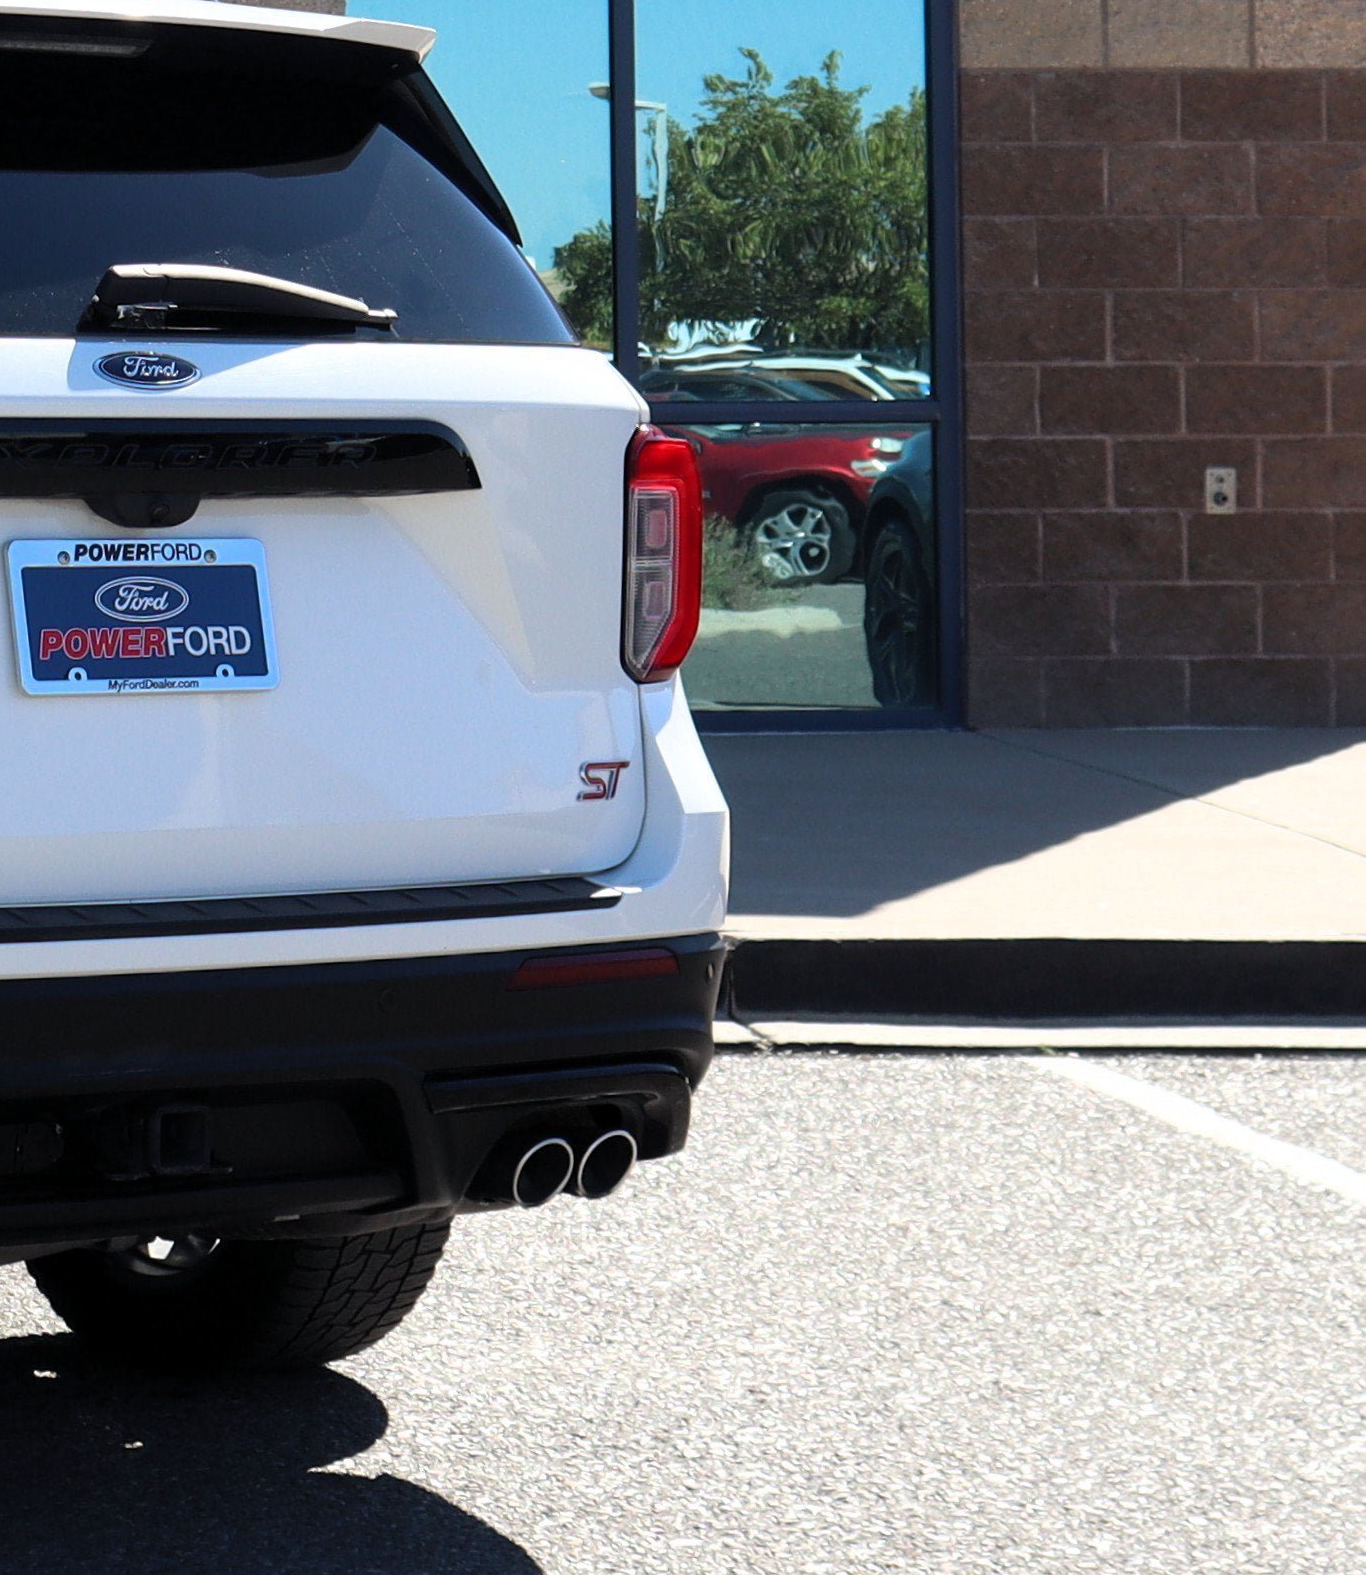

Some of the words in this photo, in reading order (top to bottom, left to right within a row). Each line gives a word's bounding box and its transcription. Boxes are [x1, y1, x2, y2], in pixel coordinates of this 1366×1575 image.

[123, 356, 179, 378] Ford
[73, 543, 203, 562] POWERFORD
[114, 584, 169, 612] Ford
[39, 625, 252, 660] POWERFORD
[107, 678, 200, 693] MyFordDealer.com
[576, 760, 631, 801] ST
